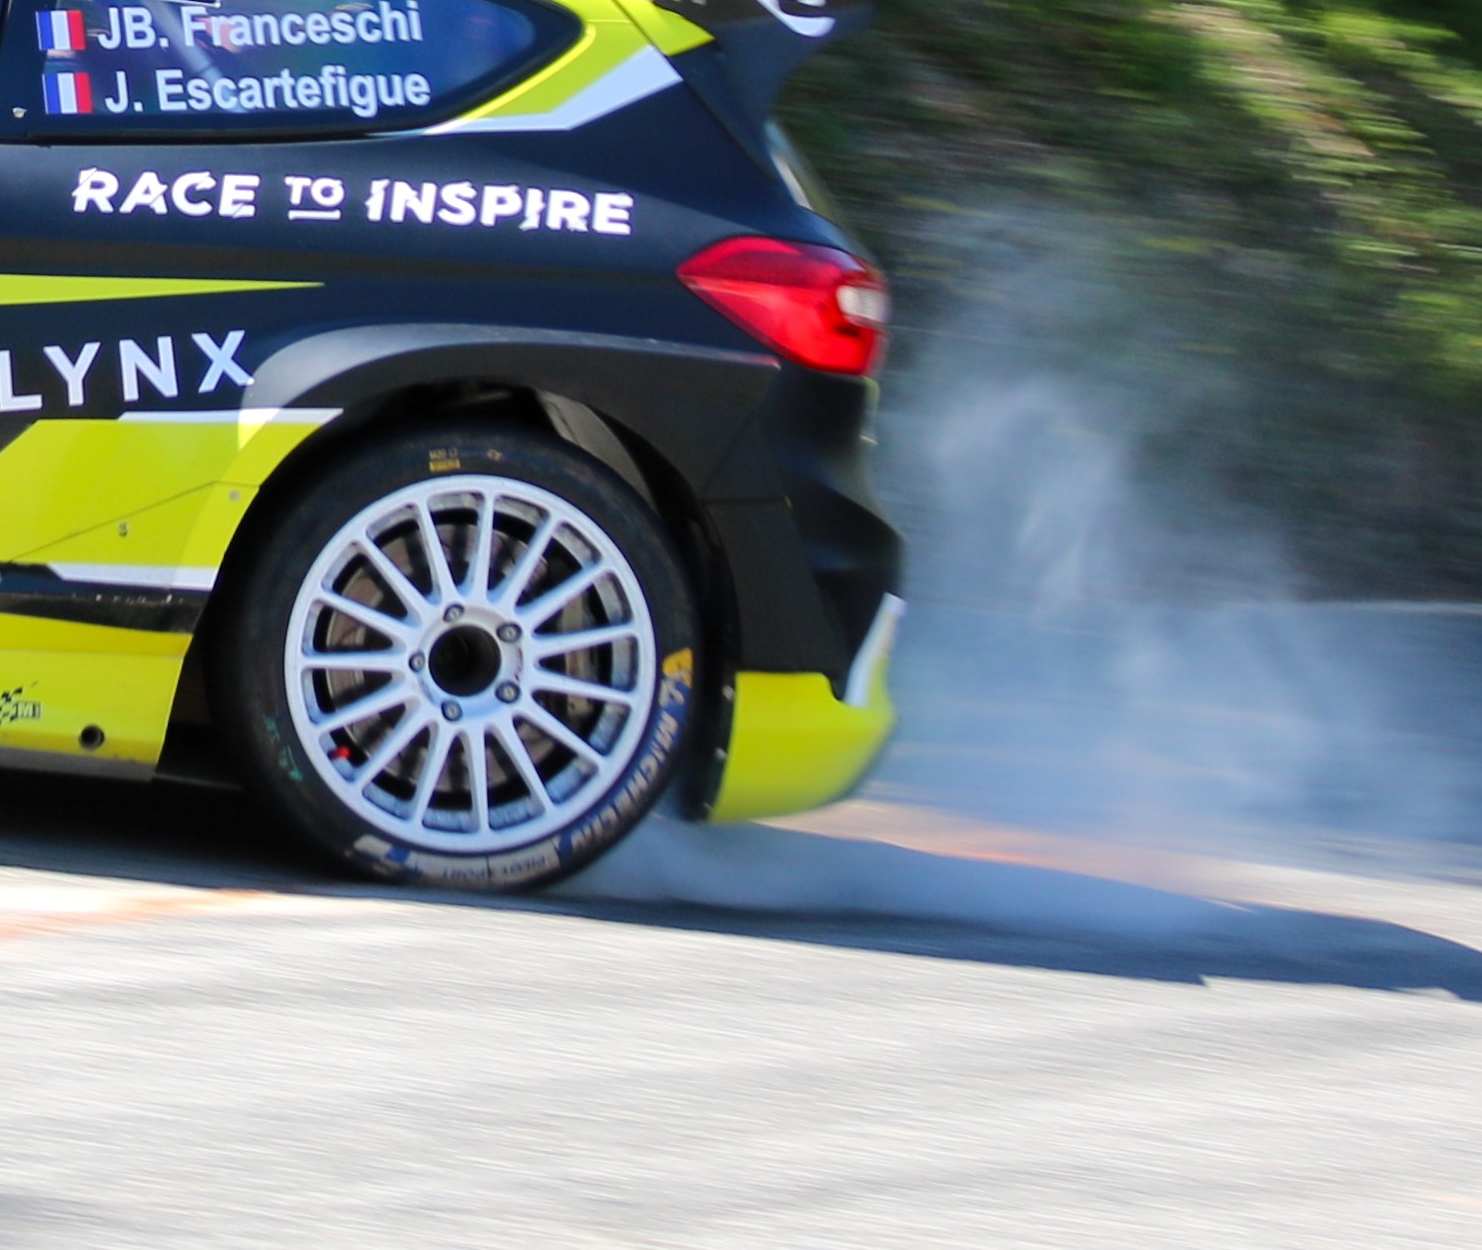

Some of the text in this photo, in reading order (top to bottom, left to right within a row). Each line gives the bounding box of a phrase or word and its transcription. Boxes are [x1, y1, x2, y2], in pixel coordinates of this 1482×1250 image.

[98, 0, 423, 49] JB. Franceschi
[105, 65, 431, 118] J. Escartefigue
[72, 167, 634, 235] RACE TO INSPIRE
[571, 711, 679, 850] MICHELIN
